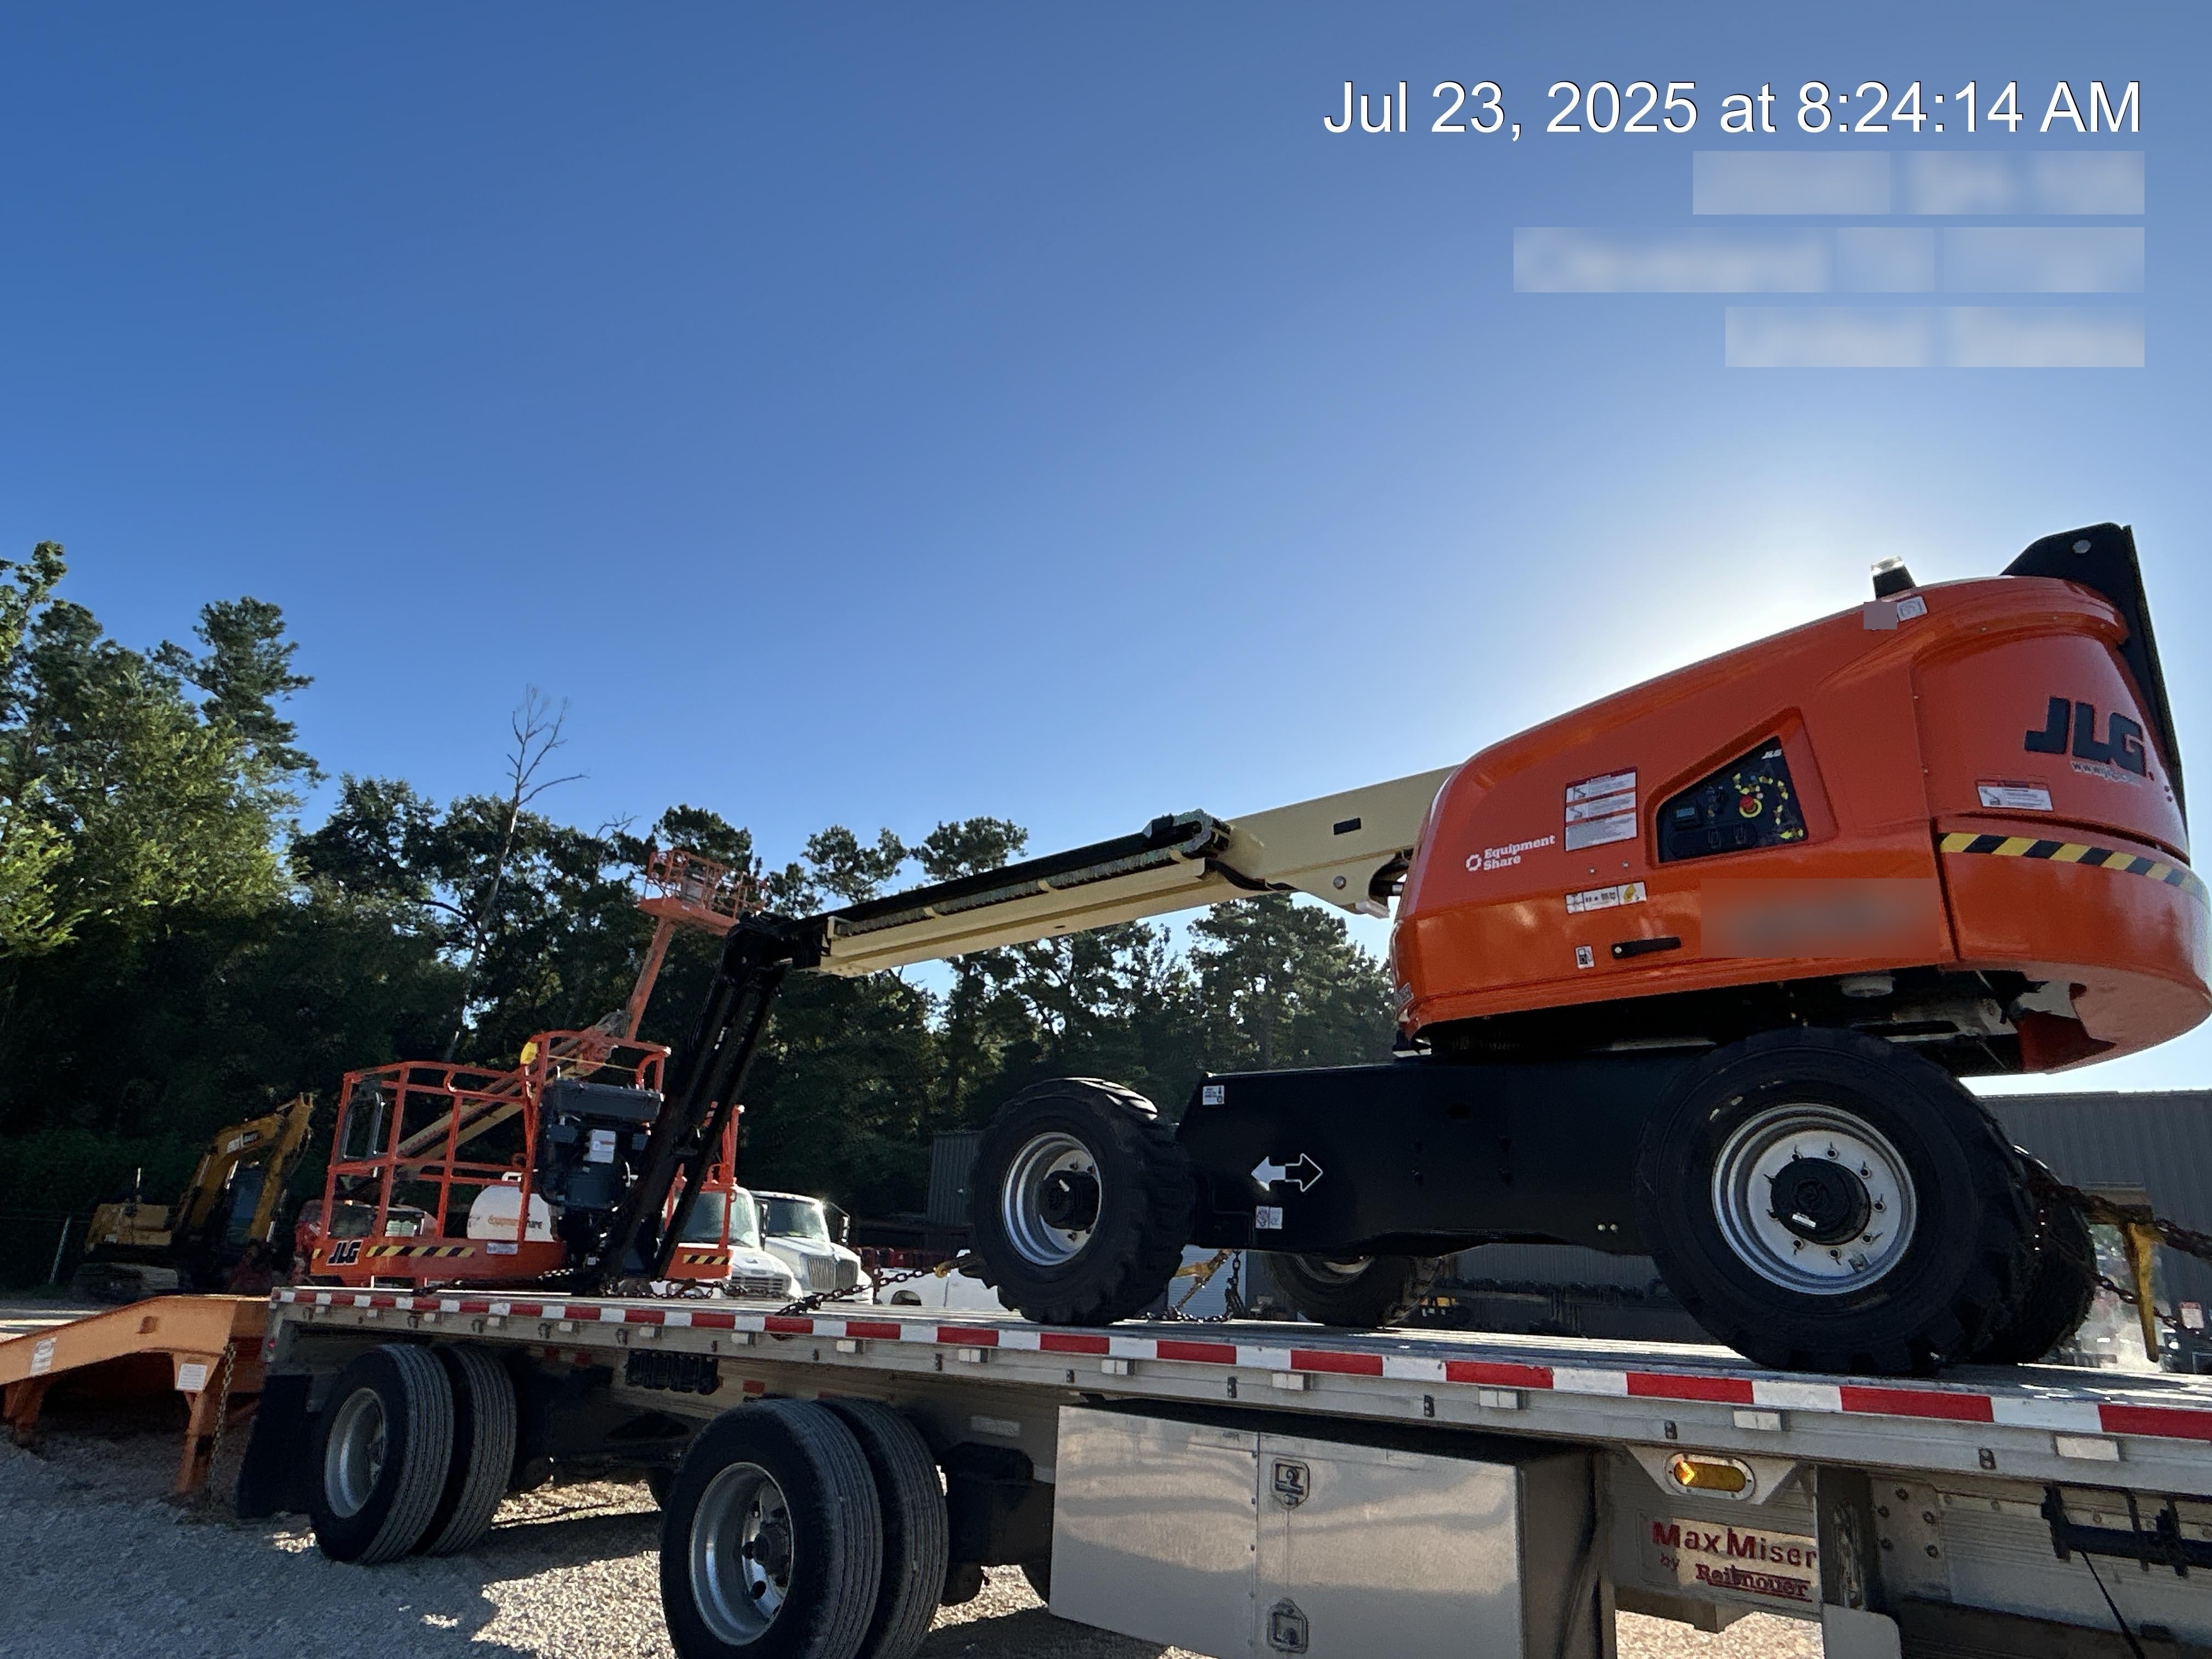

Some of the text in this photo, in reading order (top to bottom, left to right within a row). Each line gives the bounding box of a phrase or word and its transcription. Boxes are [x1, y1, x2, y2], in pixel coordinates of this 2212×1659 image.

[2024, 696, 2147, 777] JLG
[1483, 834, 1556, 859] Equipment
[1483, 855, 1522, 871] Share
[326, 1240, 362, 1265] JLG
[1652, 1521, 1816, 1569] MaxMiser
